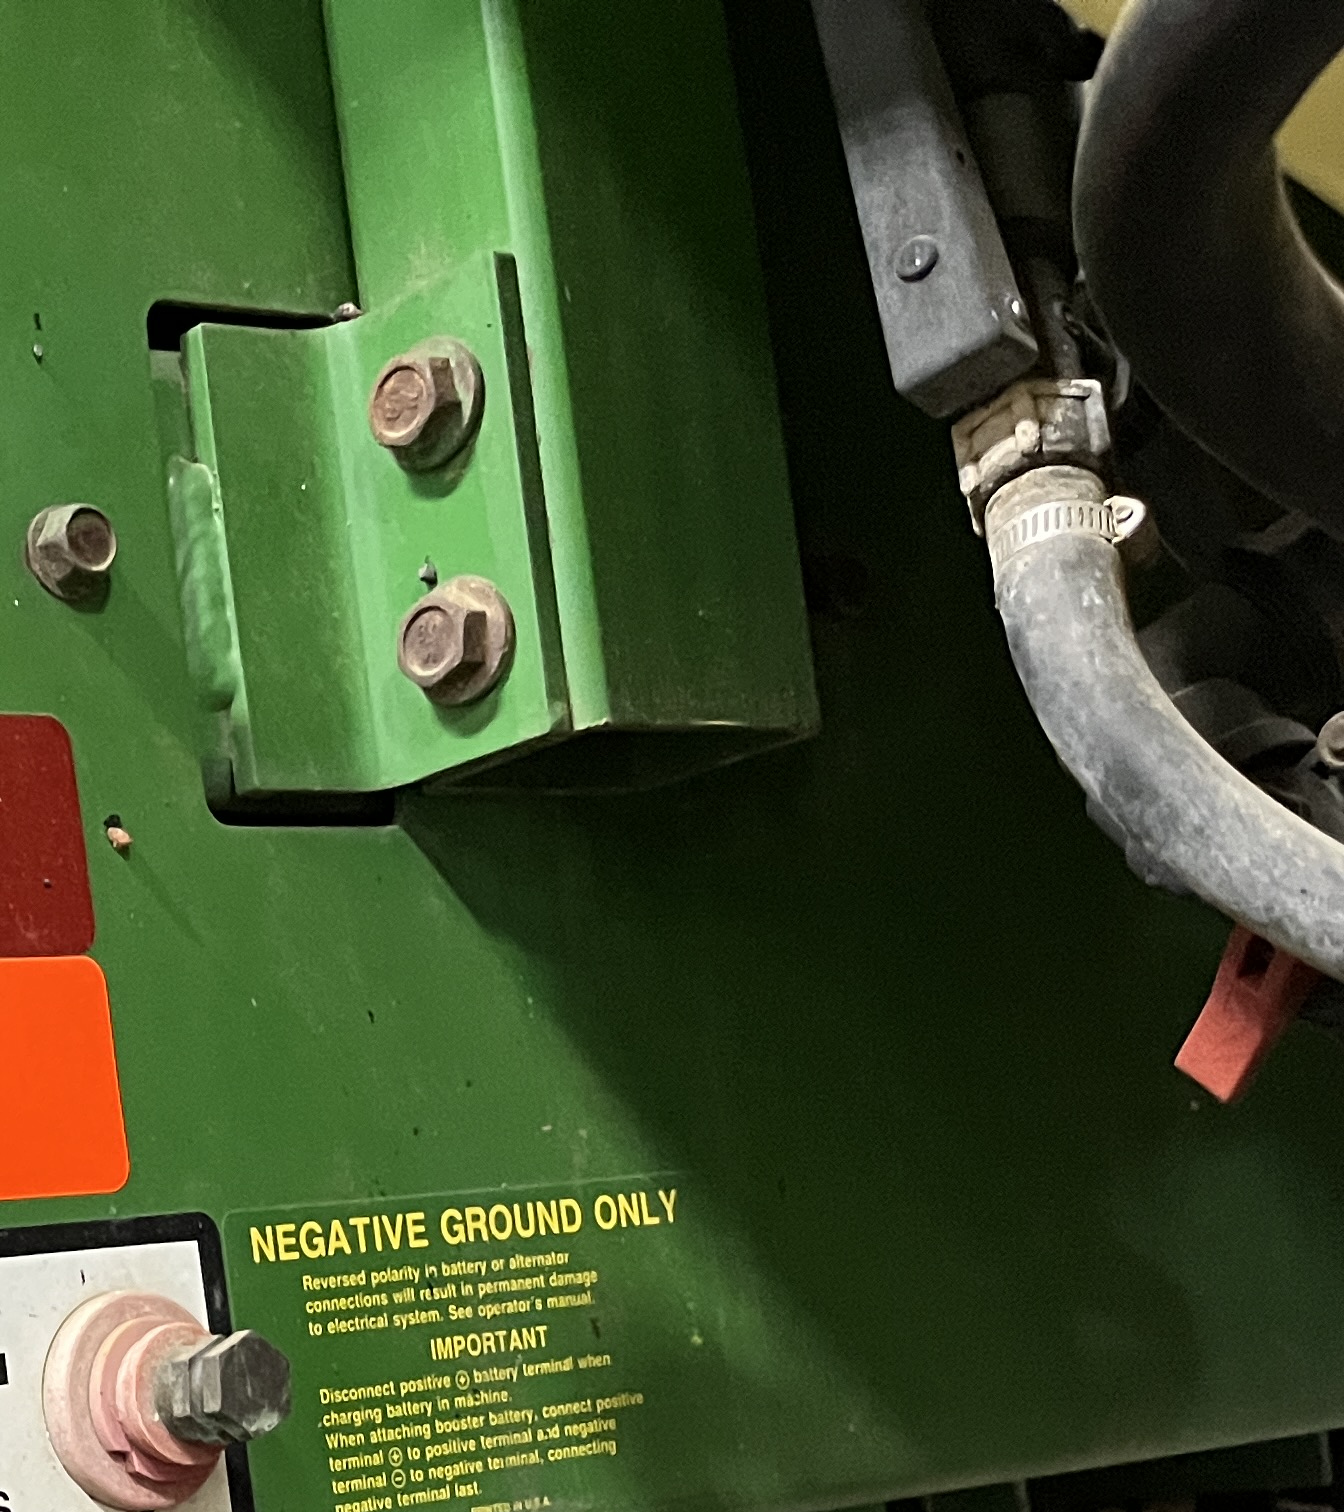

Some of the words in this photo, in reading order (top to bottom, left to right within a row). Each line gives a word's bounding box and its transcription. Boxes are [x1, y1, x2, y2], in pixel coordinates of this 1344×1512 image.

[249, 1212, 430, 1264] NEGATIVE
[440, 1198, 582, 1246] GROUND
[594, 1189, 678, 1231] ONLY
[303, 1270, 366, 1291] Reversed
[371, 1266, 420, 1288] polarity
[425, 1263, 438, 1278] in
[442, 1260, 486, 1276] battery
[491, 1259, 505, 1271] or
[509, 1251, 569, 1268] alternator
[306, 1292, 388, 1314] connections
[392, 1287, 416, 1304] will
[420, 1283, 457, 1301] result
[461, 1282, 474, 1296] in
[478, 1274, 546, 1297] permanent
[549, 1271, 598, 1287] damage
[309, 1321, 322, 1336] to
[327, 1312, 388, 1334] electrical
[393, 1310, 443, 1330] system.
[449, 1305, 473, 1320] See
[478, 1296, 542, 1319] operator's
[430, 1325, 548, 1361] IMPORTANT
[320, 1381, 395, 1404] Disconnect
[400, 1374, 451, 1396] positive
[473, 1363, 518, 1383] battery
[521, 1356, 574, 1376] terminal
[577, 1354, 611, 1368] when
[322, 1406, 382, 1428] charging
[386, 1401, 432, 1418] battery
[437, 1396, 450, 1411] in
[325, 1430, 364, 1449] When
[370, 1422, 431, 1443] attaching
[435, 1416, 485, 1433] booster
[489, 1409, 538, 1426] battery,
[542, 1399, 592, 1418] connect
[596, 1391, 644, 1410] positive
[329, 1450, 384, 1471] terminal
[407, 1447, 420, 1460] to
[425, 1439, 476, 1460] positive
[480, 1428, 532, 1449] terminal
[564, 1418, 616, 1438] negative
[332, 1472, 386, 1494] terminal
[410, 1469, 423, 1482] to
[428, 1460, 483, 1481] negative
[487, 1449, 544, 1470] terminal,
[548, 1439, 616, 1461] connecting
[397, 1484, 450, 1507] terminal
[455, 1481, 482, 1497] last.
